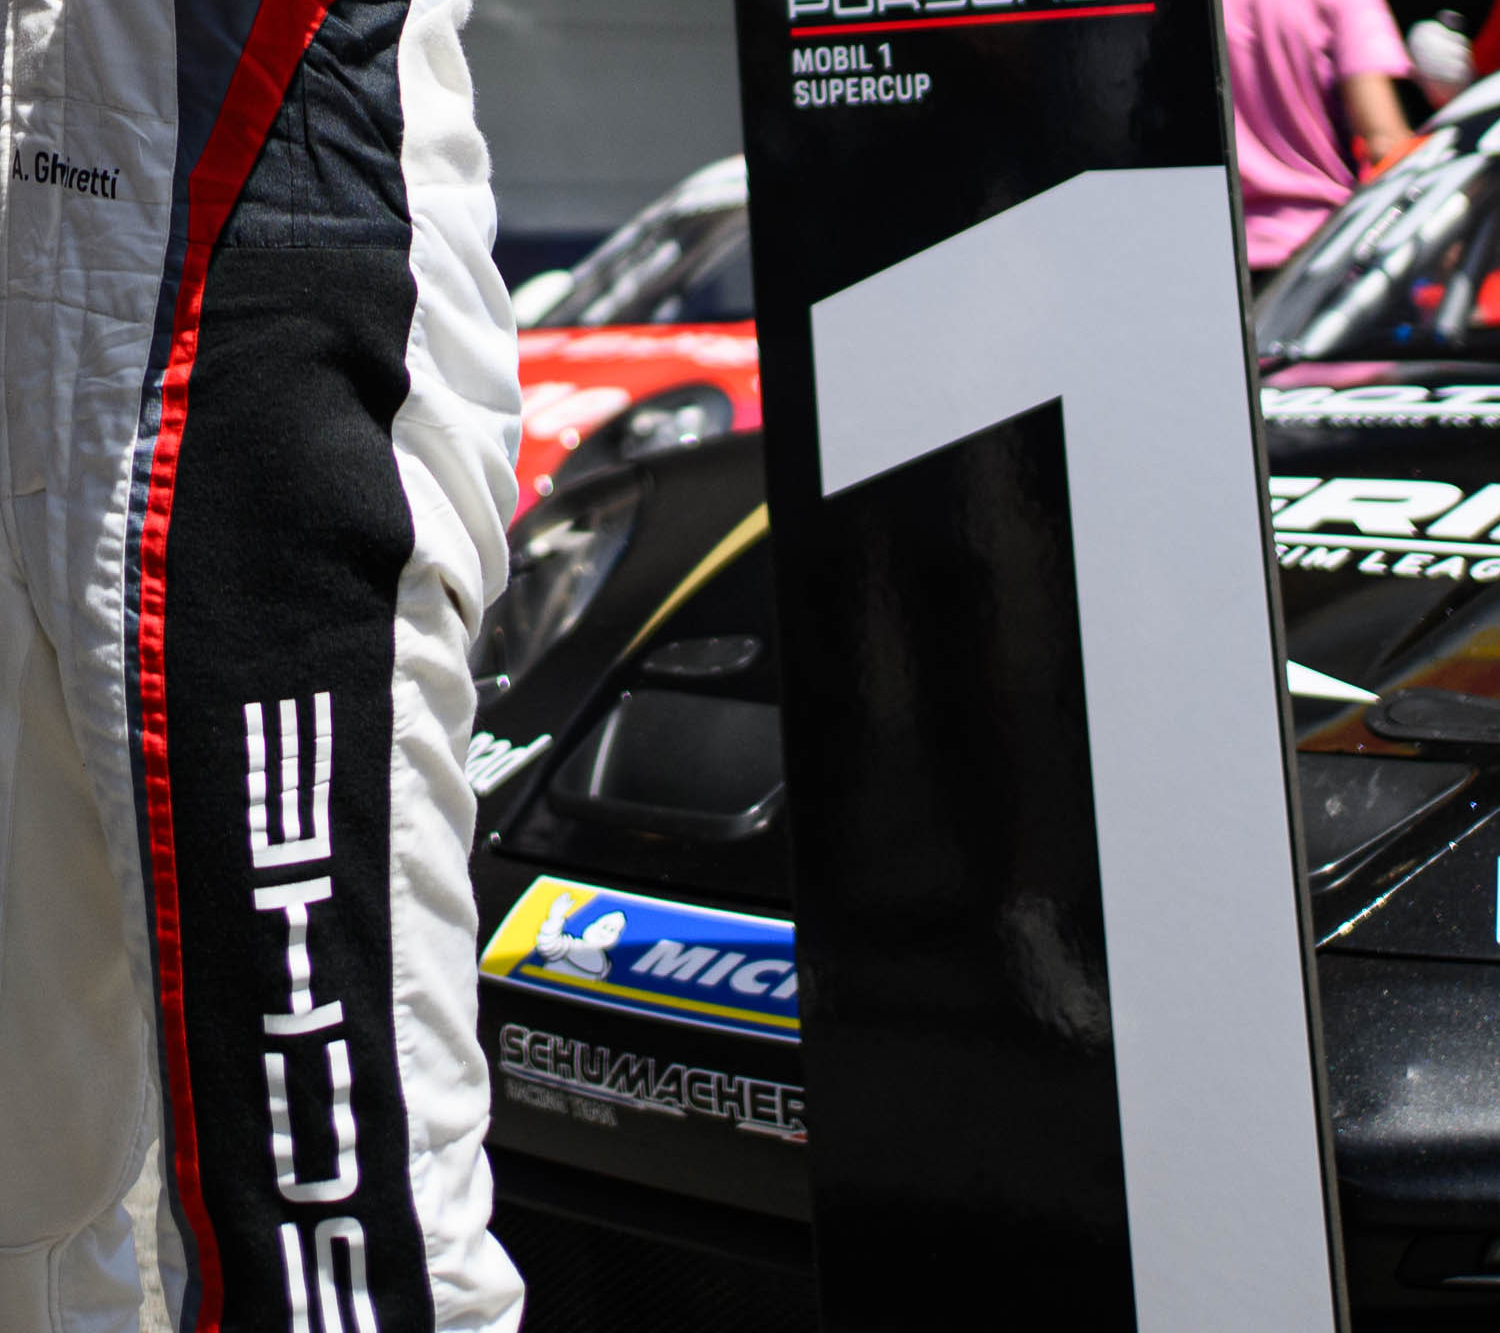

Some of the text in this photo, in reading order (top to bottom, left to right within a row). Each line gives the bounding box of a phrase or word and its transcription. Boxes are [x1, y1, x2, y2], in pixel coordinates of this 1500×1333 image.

[792, 44, 892, 76] MOBIL 1
[793, 73, 931, 109] SUPERCUP
[12, 148, 121, 200] A. Ghiretti
[810, 165, 1331, 1333] 1
[499, 1023, 806, 1133] SCHUMACHER
